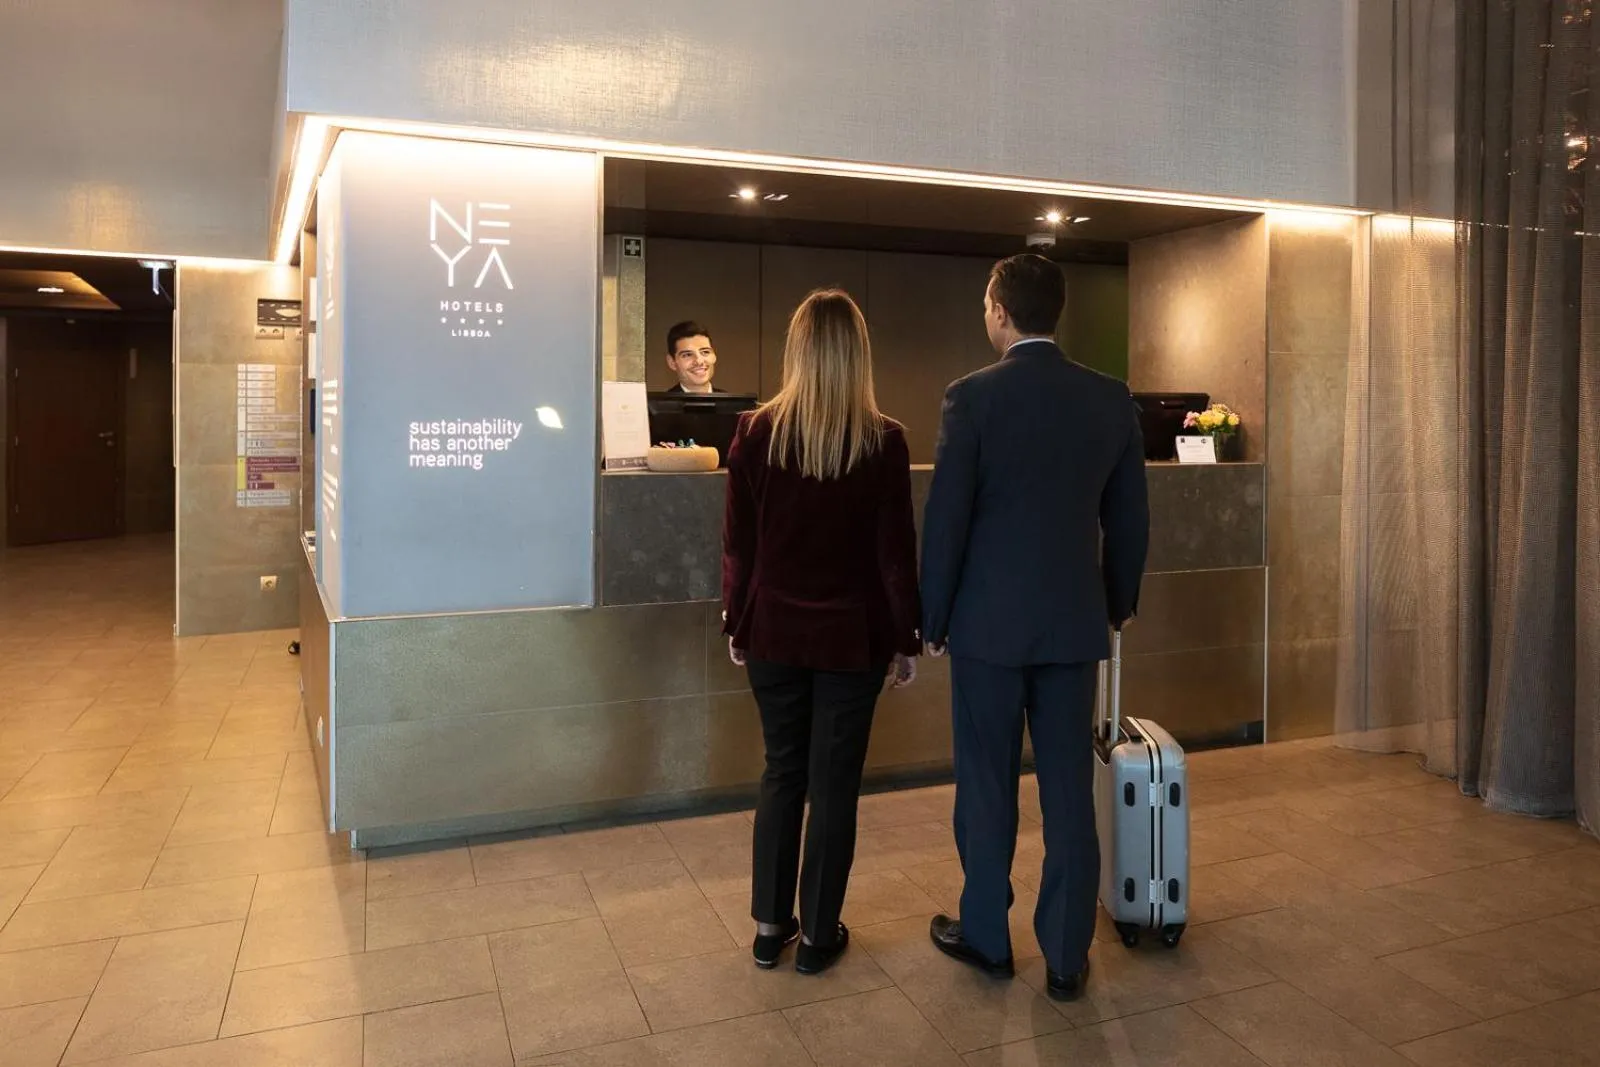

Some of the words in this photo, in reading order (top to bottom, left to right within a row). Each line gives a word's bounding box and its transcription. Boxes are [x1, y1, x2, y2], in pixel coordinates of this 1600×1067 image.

[440, 300, 504, 314] HOTELS
[451, 329, 492, 338] LISBOA
[408, 418, 523, 439] sustainability
[409, 435, 440, 451] has
[446, 435, 512, 451] another
[408, 450, 484, 470] meaning
